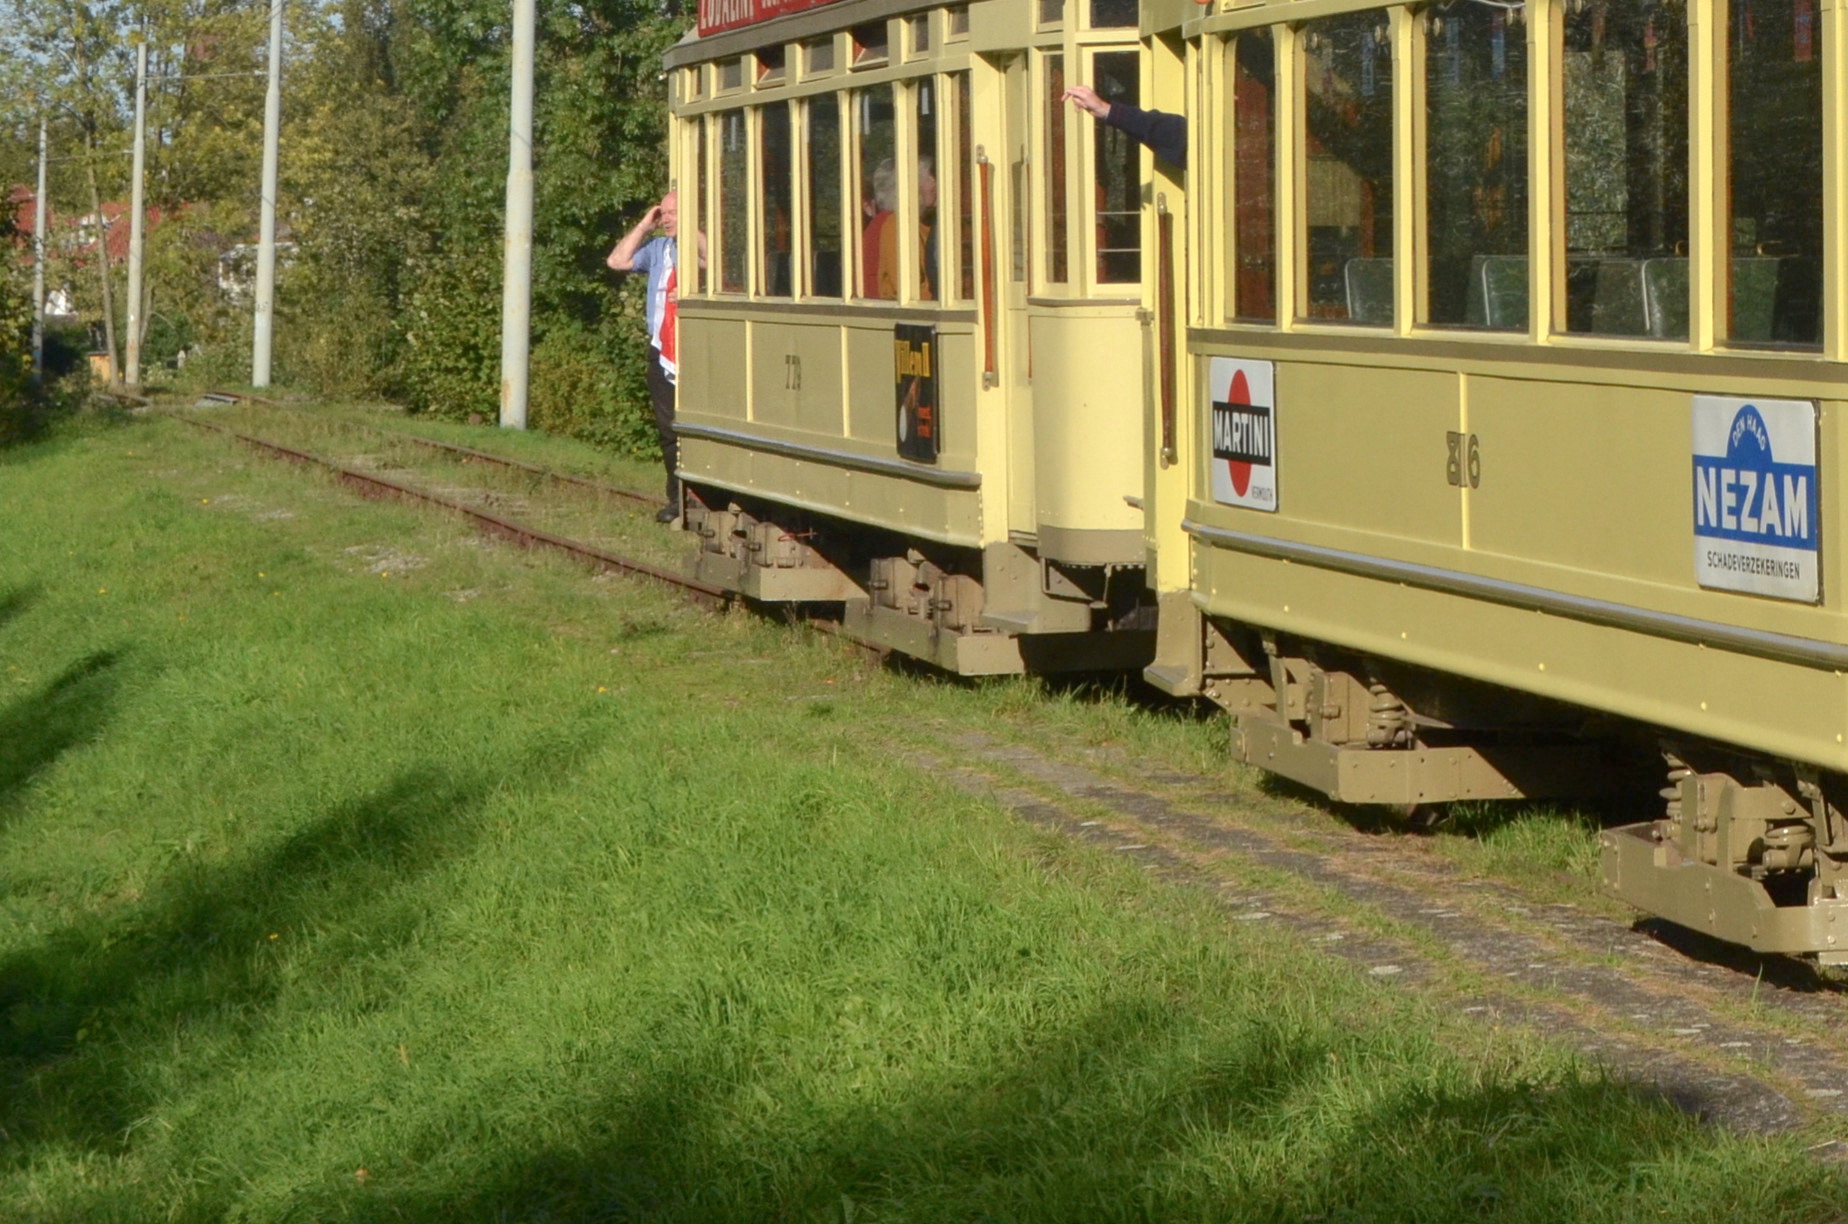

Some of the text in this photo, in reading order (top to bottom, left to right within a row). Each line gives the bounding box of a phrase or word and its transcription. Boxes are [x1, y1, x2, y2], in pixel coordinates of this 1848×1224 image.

[1214, 409, 1269, 457] MARTINI
[1732, 414, 1766, 451] DEN HAAG
[1446, 430, 1480, 489] 816
[1696, 465, 1808, 539] NEZAM
[1707, 550, 1800, 580] SCHADEVERZEKERINGEN
